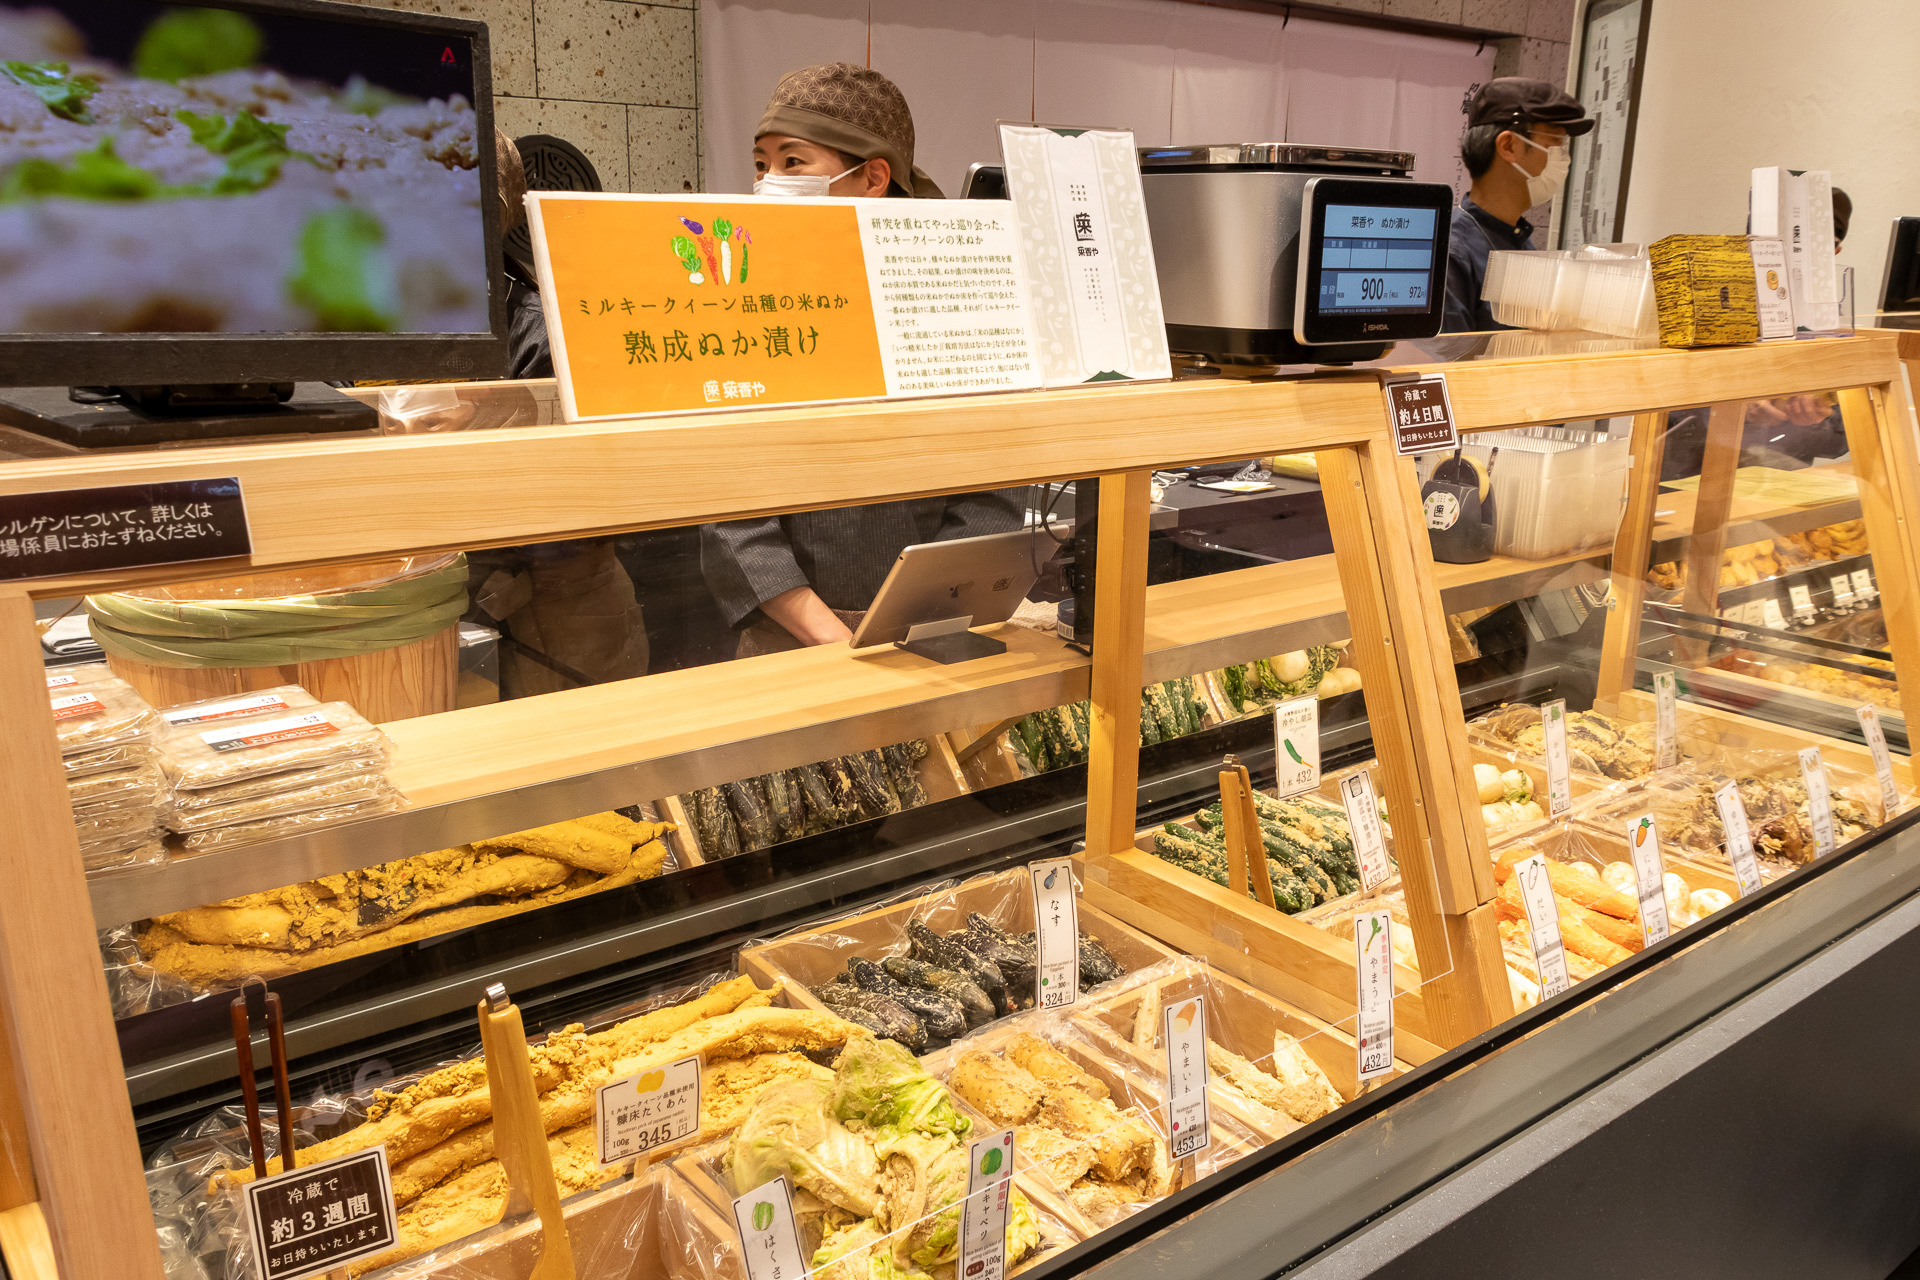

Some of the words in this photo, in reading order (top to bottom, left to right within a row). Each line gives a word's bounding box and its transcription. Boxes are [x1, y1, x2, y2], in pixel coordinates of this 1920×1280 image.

[871, 217, 1005, 231] 研究を重ねてやっと巡り会った、
[1351, 216, 1374, 229] 菜香や
[1381, 217, 1410, 229] ぬか漬け
[874, 234, 984, 246] ミルキークイーンの米ぬか
[579, 294, 849, 316] ミルキークィーン品種の米ぬか
[1367, 323, 1389, 332] ISHIDA
[623, 326, 819, 365] 熟成ぬか漬け
[1404, 389, 1427, 402] 冷蔵で
[1401, 429, 1449, 443] お日持ちいたします
[1296, 768, 1312, 785] 432
[1050, 900, 1061, 928] なす
[617, 1095, 687, 1126] 糠床たくあん
[613, 1138, 630, 1149] 100g
[287, 1177, 339, 1205] 冷蔵で
[270, 1225, 379, 1268] お日持ちいたします
[986, 1255, 1001, 1267] 100g
